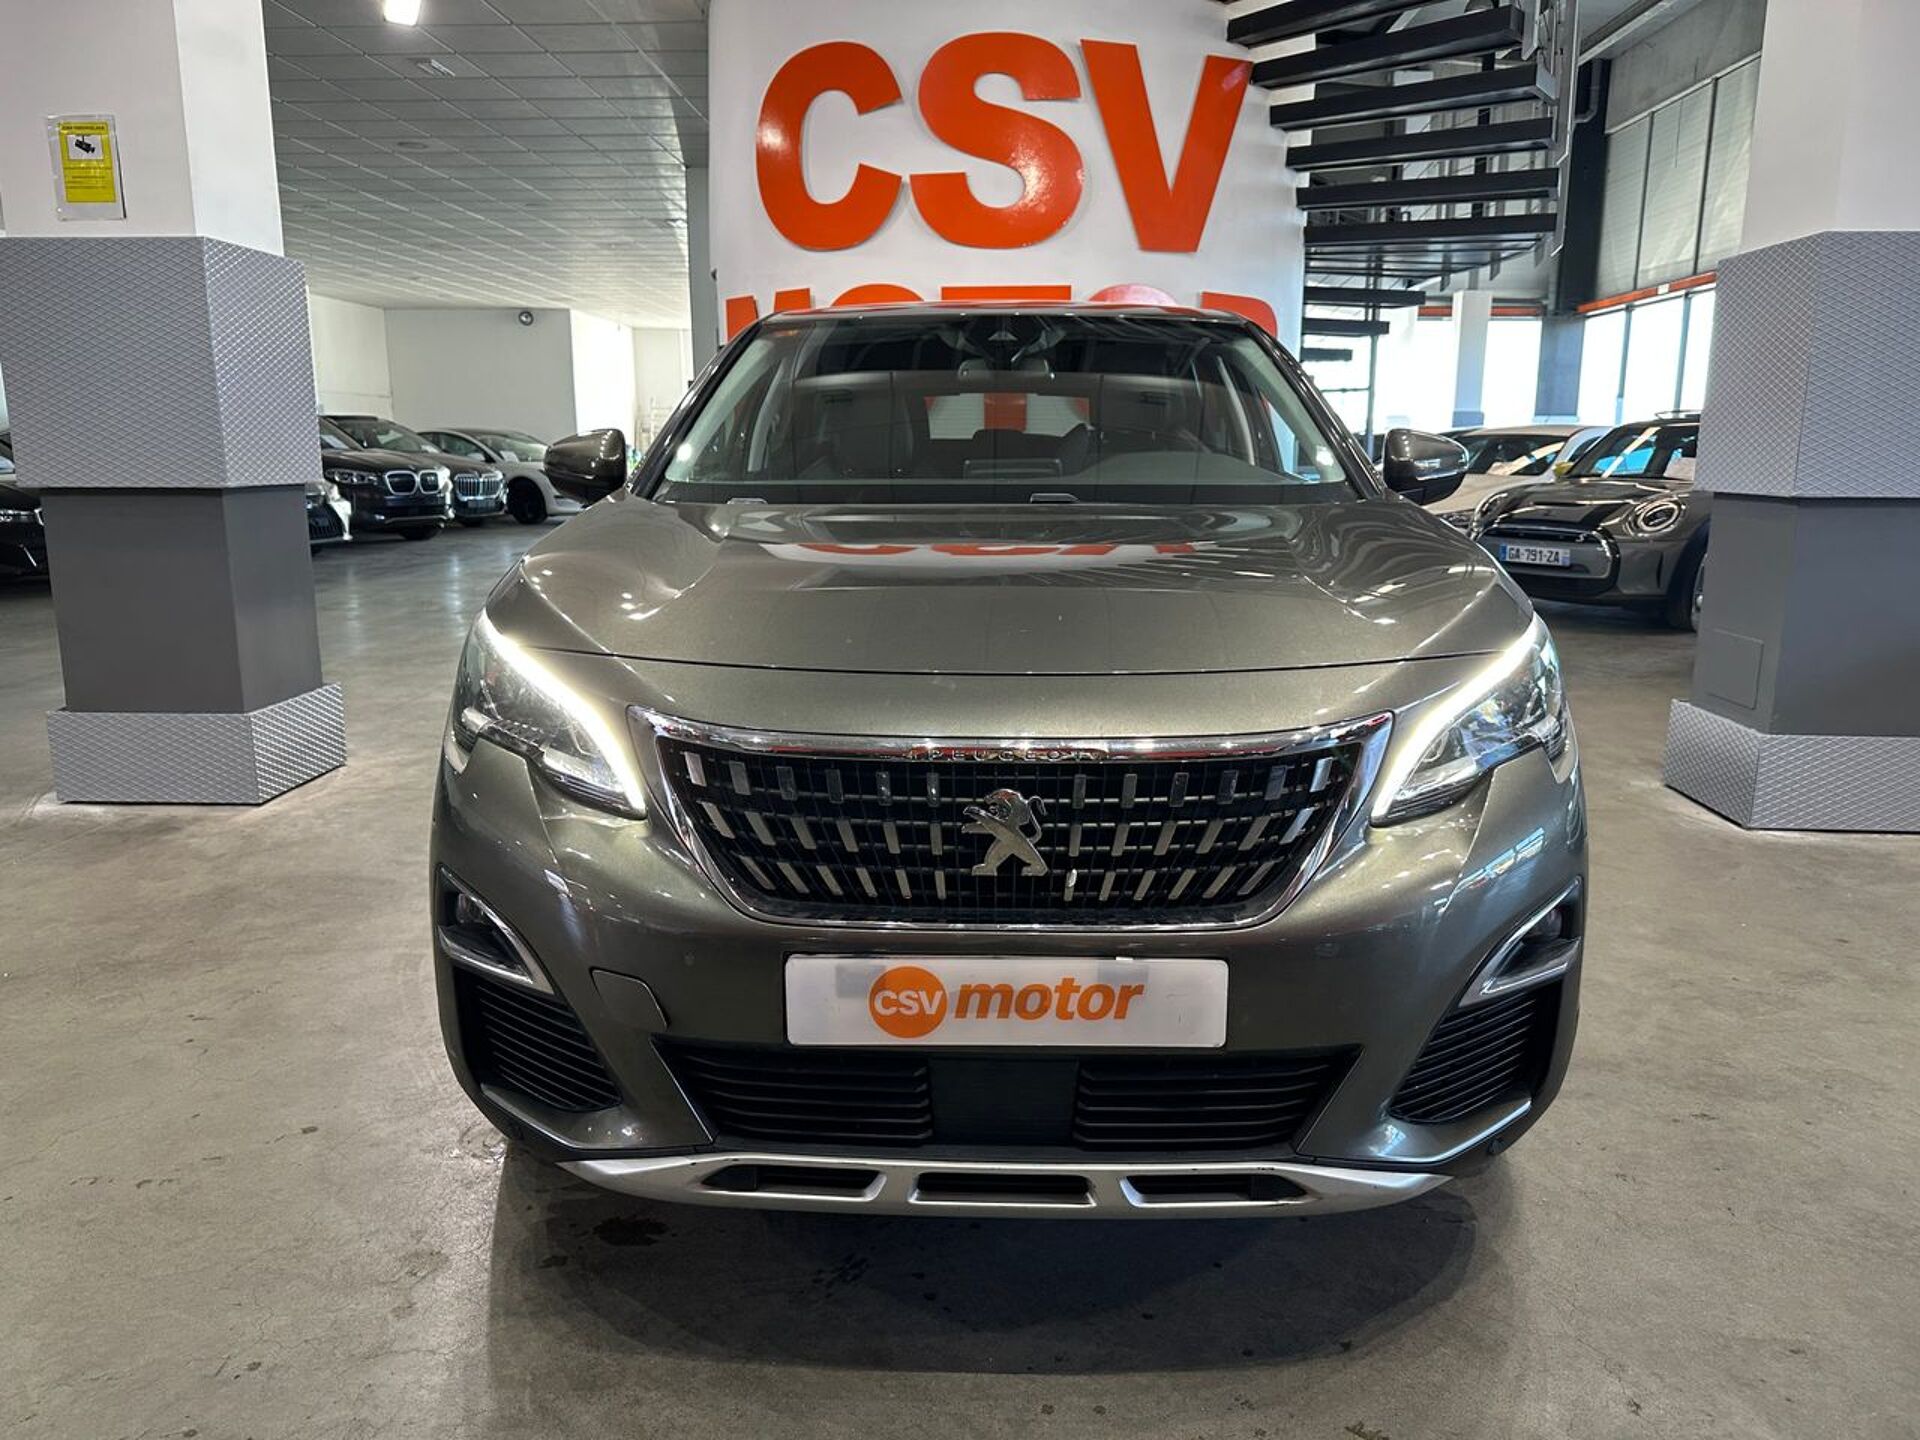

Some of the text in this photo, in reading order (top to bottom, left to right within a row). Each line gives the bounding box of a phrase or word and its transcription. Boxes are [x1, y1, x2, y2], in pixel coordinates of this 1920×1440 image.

[756, 31, 1253, 253] CSV
[1508, 547, 1560, 563] GA-791-ZA
[874, 977, 1145, 1021] CSV motor
